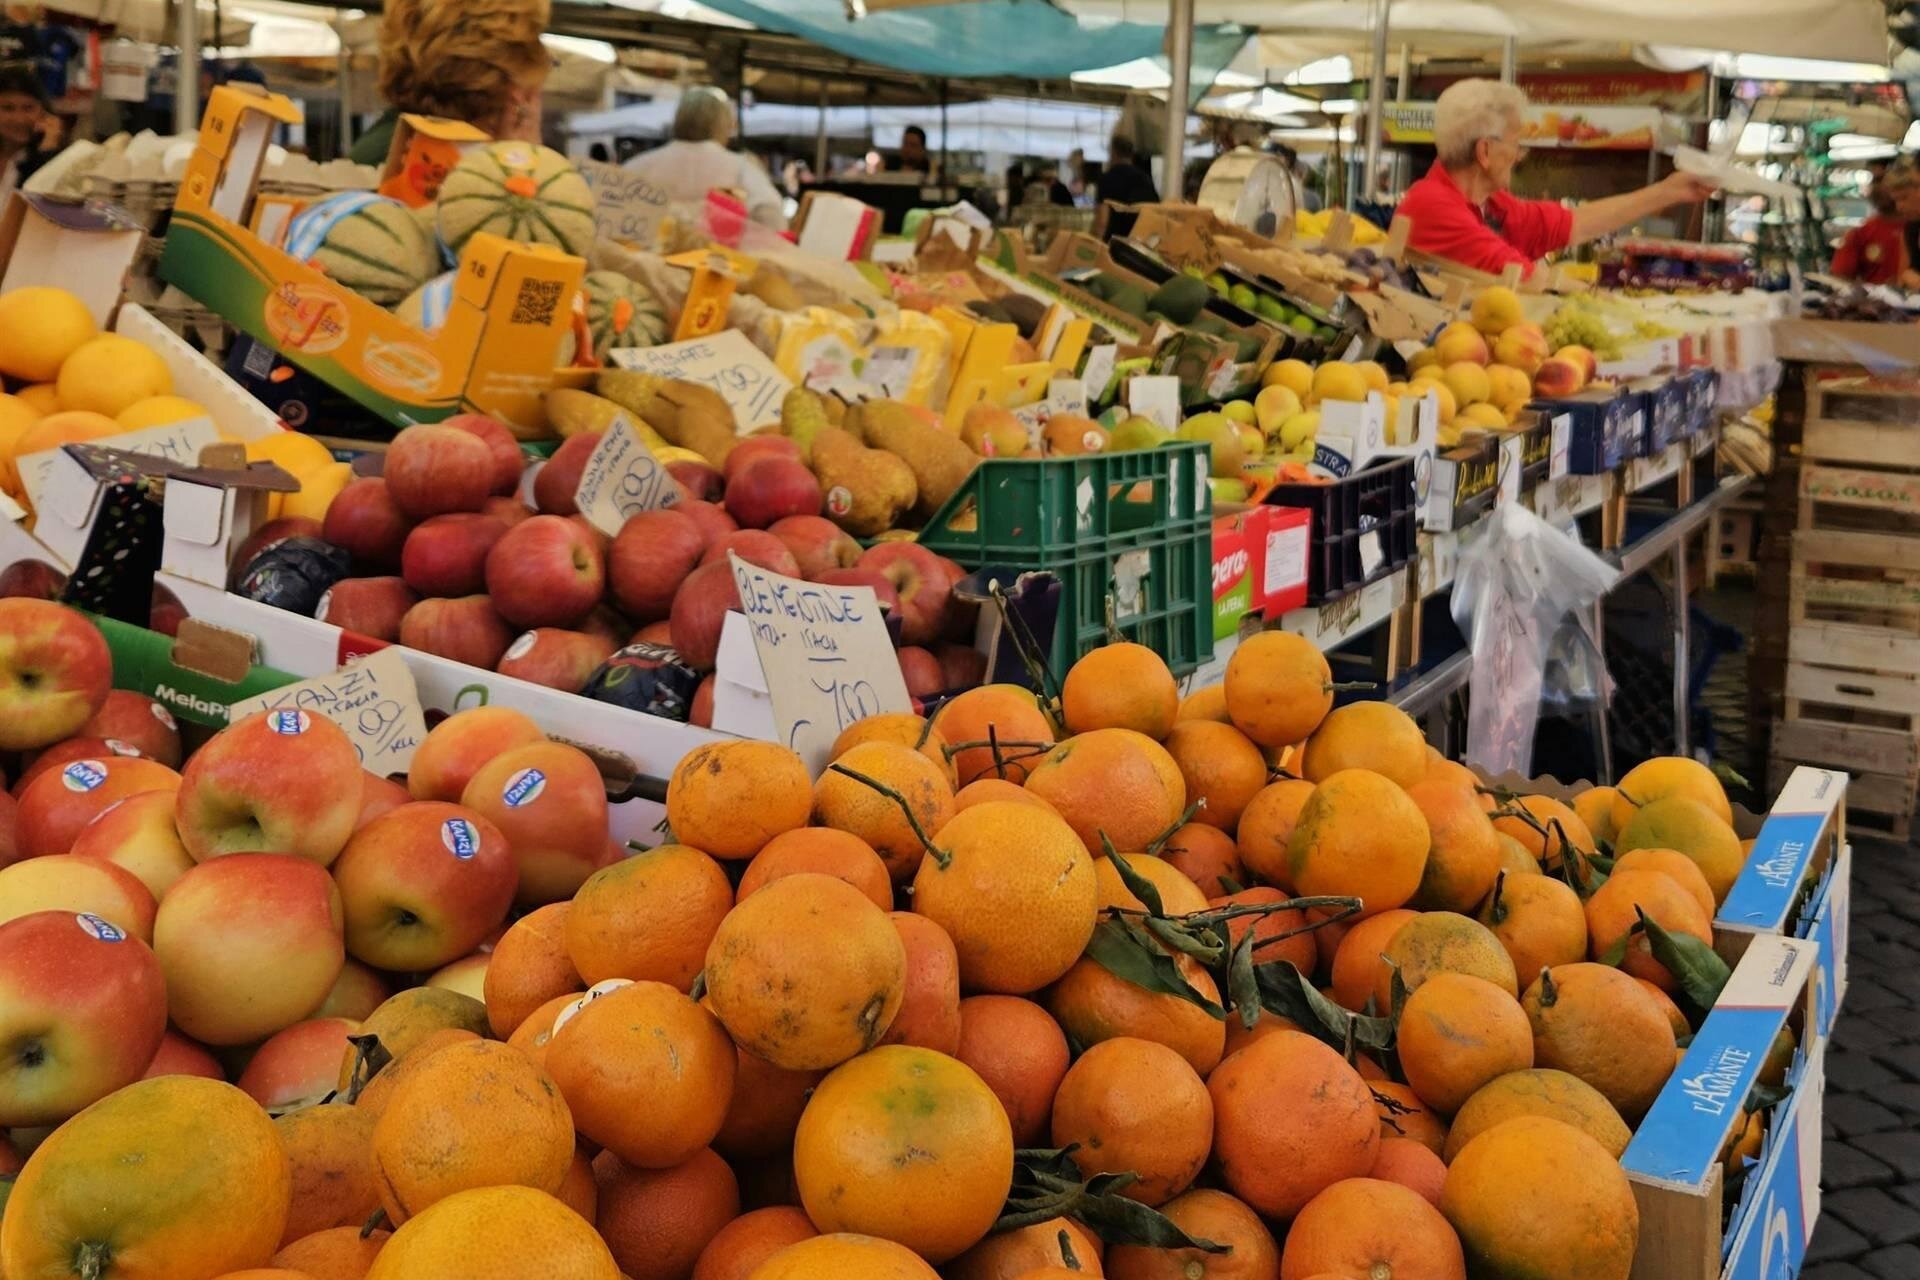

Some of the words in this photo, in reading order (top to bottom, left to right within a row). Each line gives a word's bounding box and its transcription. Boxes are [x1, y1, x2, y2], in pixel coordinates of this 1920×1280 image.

[210, 115, 224, 134] 18
[471, 260, 487, 279] 18
[737, 566, 863, 624] CLEMENTINE
[450, 820, 472, 853] KANZI
[1683, 1047, 1751, 1116] L'AMANTE
